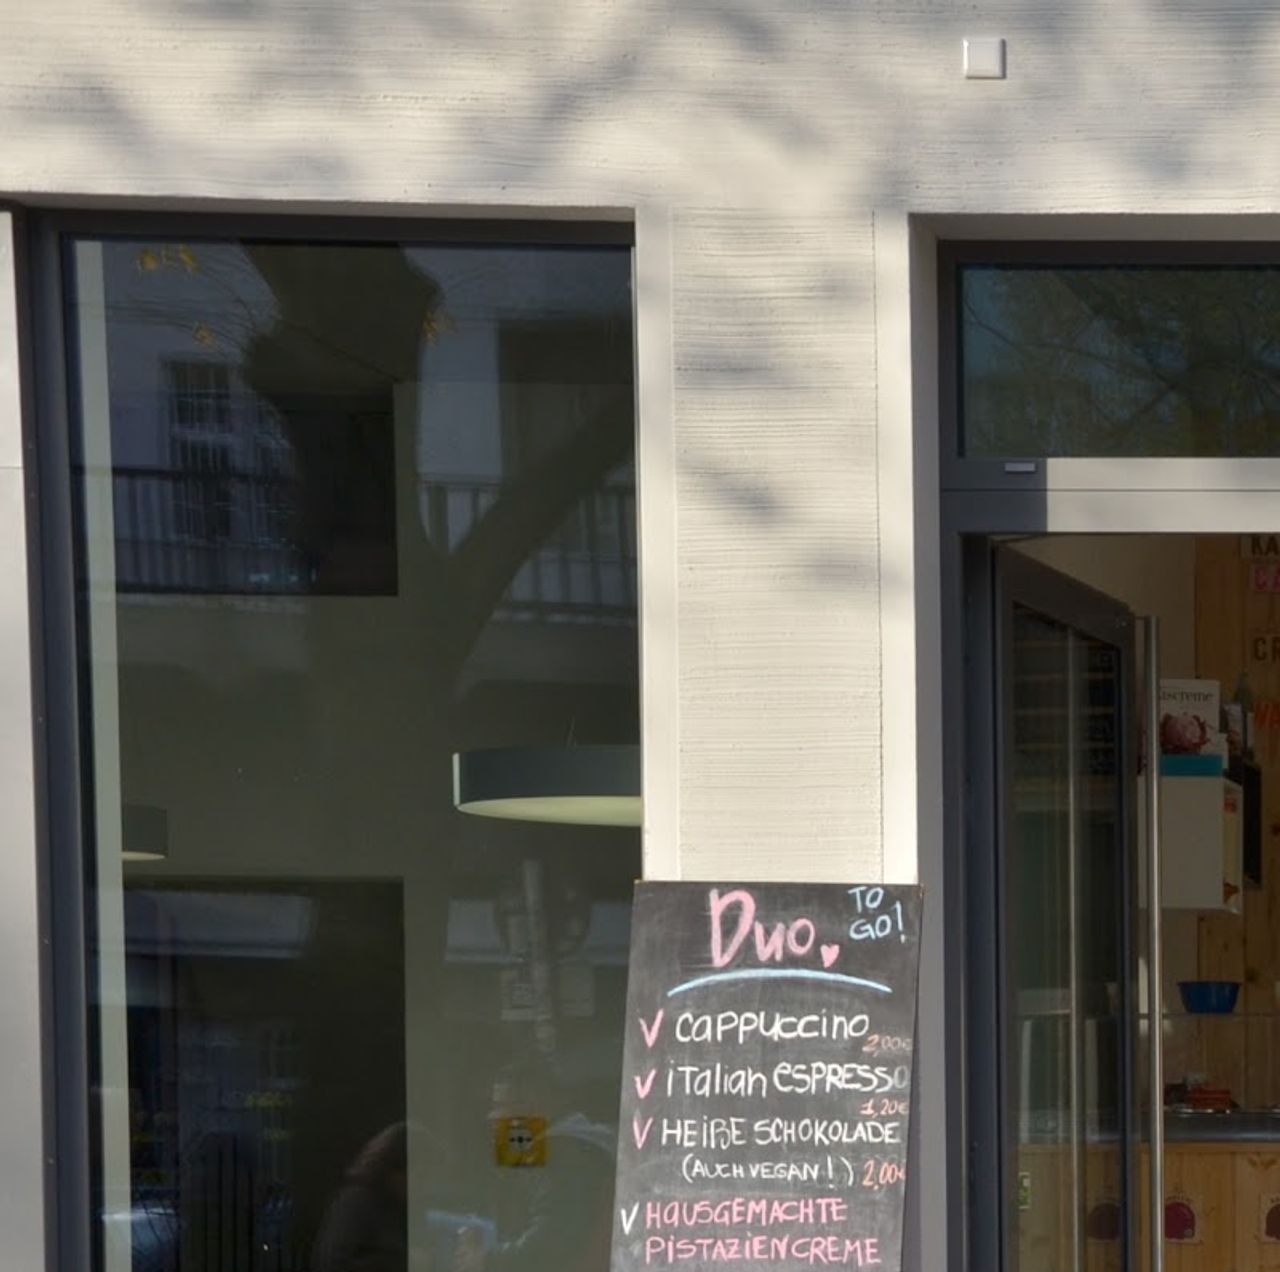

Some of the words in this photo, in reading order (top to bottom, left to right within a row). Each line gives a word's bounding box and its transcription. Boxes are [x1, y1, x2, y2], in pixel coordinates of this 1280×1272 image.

[848, 886, 884, 912] TO
[850, 901, 905, 943] GO!
[754, 1117, 901, 1145] SCHOKOLADE
